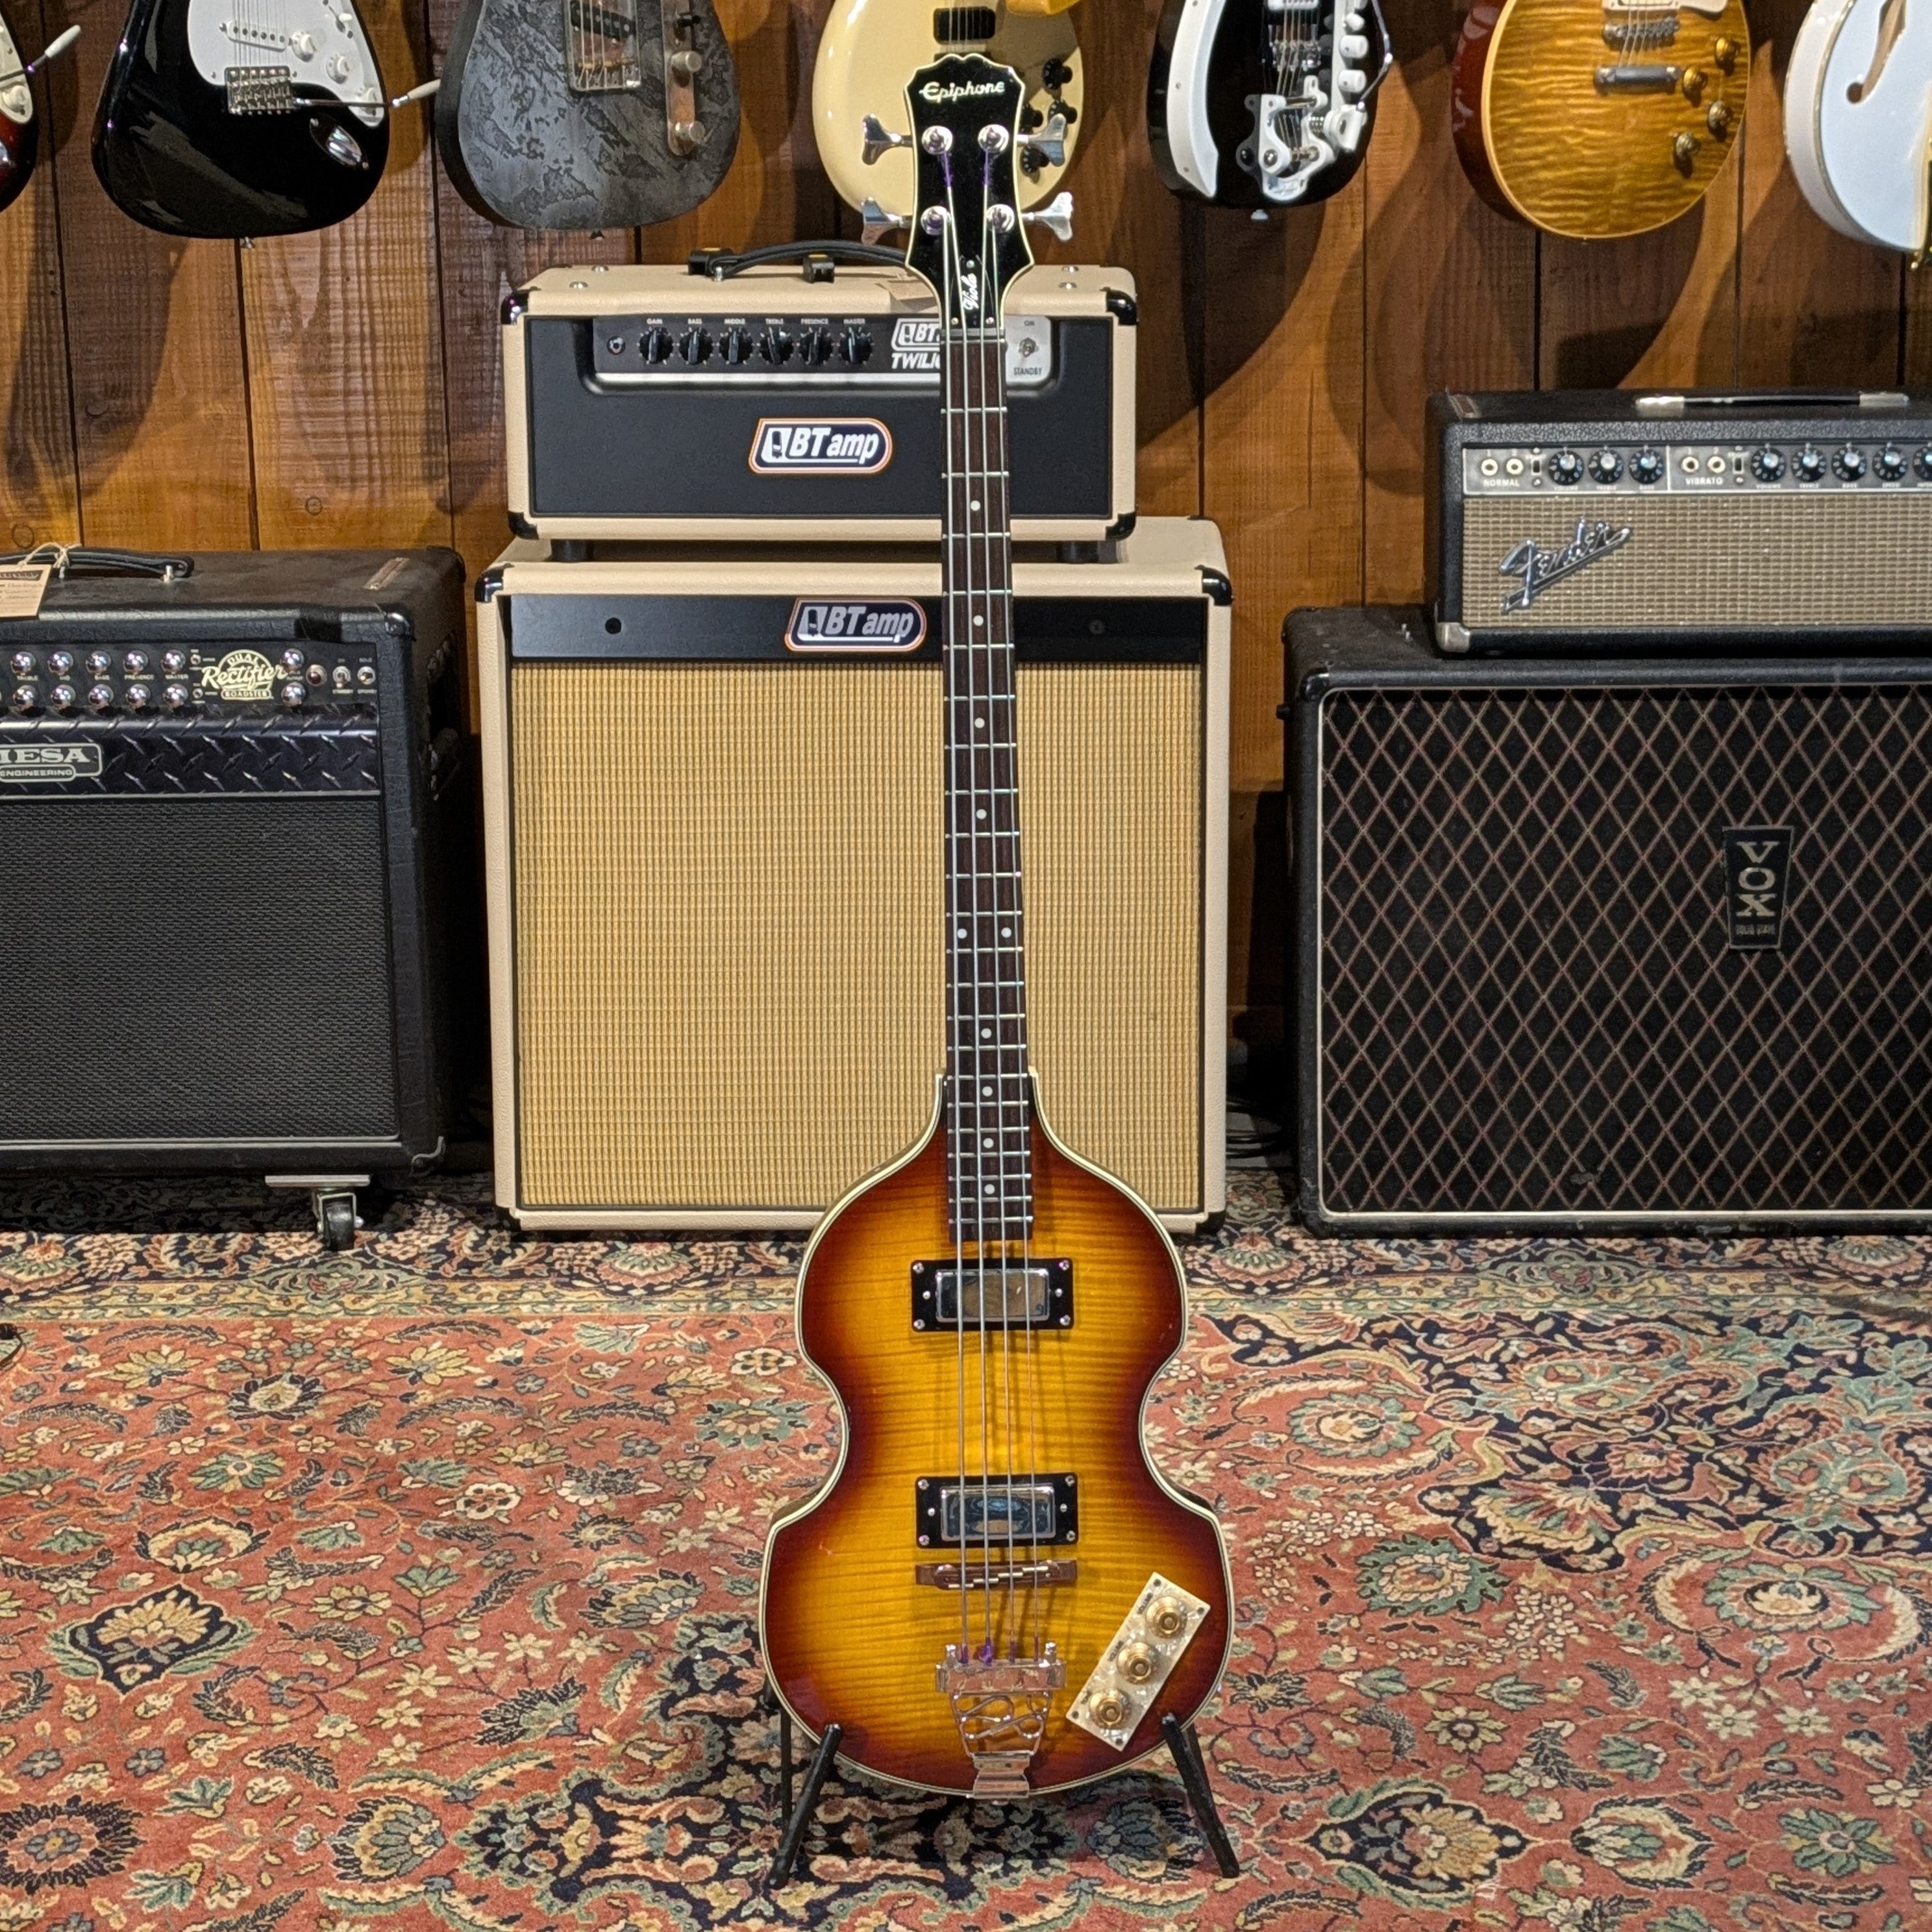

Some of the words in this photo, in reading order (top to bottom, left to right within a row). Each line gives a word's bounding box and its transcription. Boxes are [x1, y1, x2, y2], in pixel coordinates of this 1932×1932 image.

[919, 80, 1005, 103] Epiphone
[826, 433, 879, 464] amp
[1685, 477, 1723, 485] VIBRATO
[1500, 517, 1630, 610] Fender
[862, 612, 913, 643] amp
[227, 653, 260, 668] DUAL
[201, 663, 288, 690] Rectifier
[1735, 841, 1780, 917] VOX
[1137, 1592, 1153, 1615] VOLUME
[1108, 1641, 1124, 1662] VOLUME
